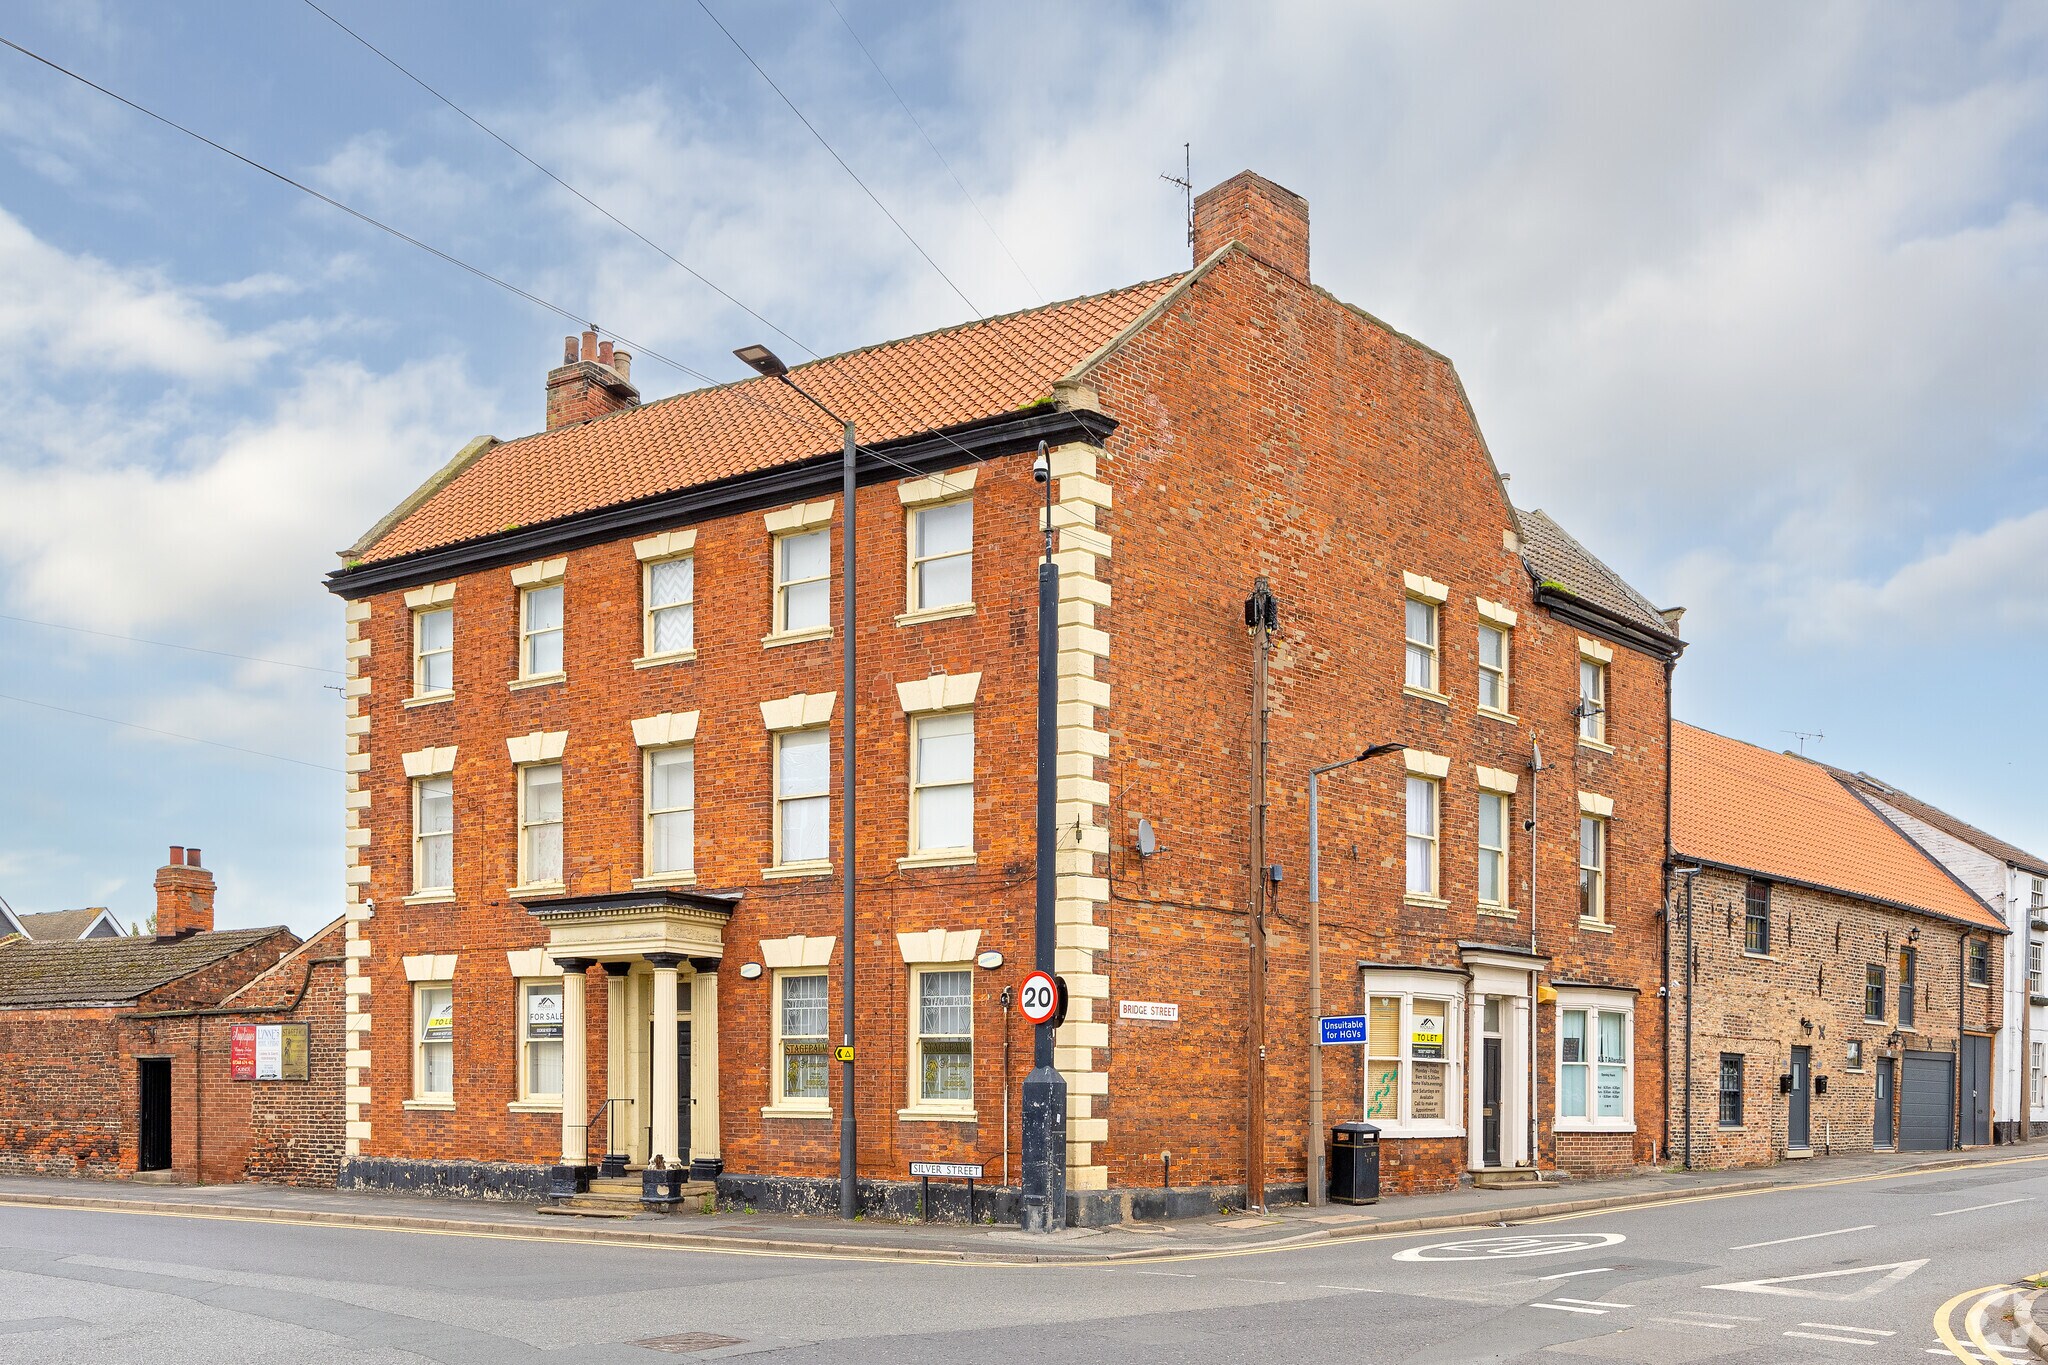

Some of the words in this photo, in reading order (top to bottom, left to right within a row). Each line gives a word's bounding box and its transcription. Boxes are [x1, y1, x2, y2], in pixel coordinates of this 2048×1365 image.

[1024, 986, 1051, 1008] 20
[1123, 1004, 1147, 1015] BRIDGE
[1150, 1006, 1176, 1017] STREET
[530, 1013, 544, 1021] FOR
[546, 1012, 564, 1020] SALE
[1324, 1020, 1364, 1030] Unsuitable
[1326, 1031, 1337, 1039] for
[1339, 1030, 1361, 1038] HGVs
[785, 1044, 827, 1054] STAGEPALM
[913, 1164, 942, 1174] SILVER
[946, 1165, 980, 1175] STREET
[1439, 1238, 1590, 1254] 20
